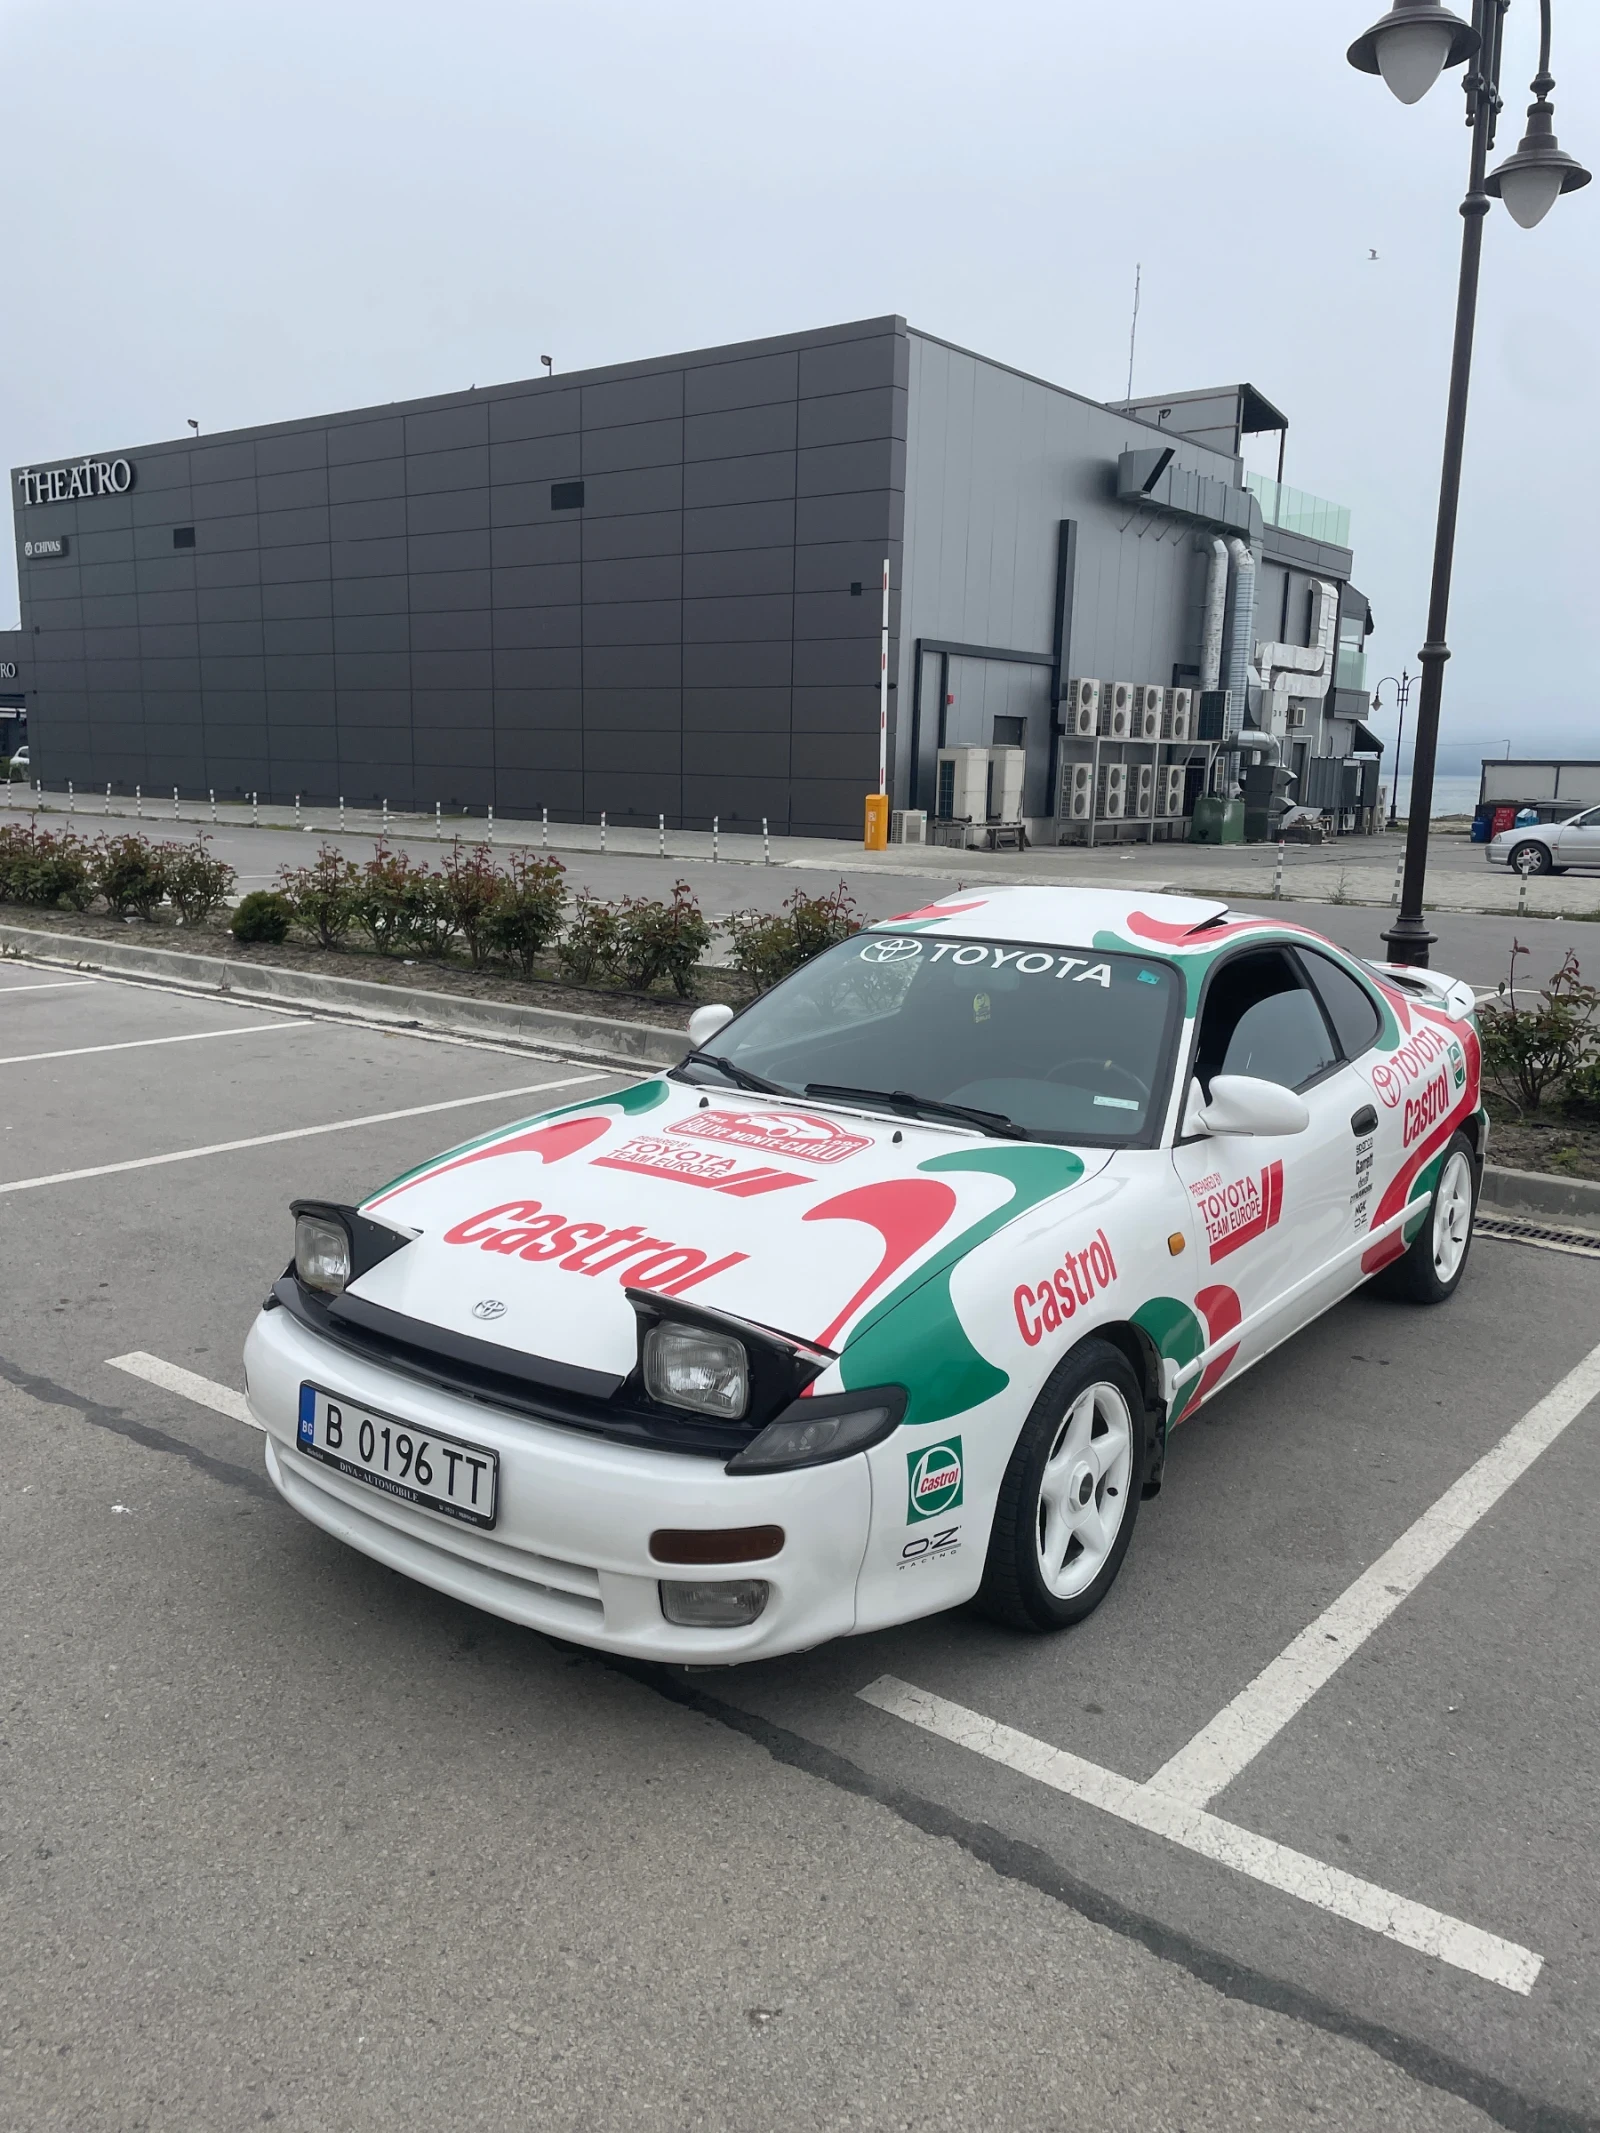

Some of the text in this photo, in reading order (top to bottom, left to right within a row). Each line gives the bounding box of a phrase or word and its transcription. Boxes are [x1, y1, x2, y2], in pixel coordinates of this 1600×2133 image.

[19, 458, 131, 505] THEATRO
[34, 540, 61, 554] CHIVAS
[930, 943, 1112, 988] TOYOTA
[1389, 1026, 1449, 1085] TOYOTA
[1403, 1063, 1449, 1149] Castrol
[620, 1140, 737, 1171] TOYOTA
[635, 1135, 679, 1147] PREPARED
[676, 1117, 853, 1160] RALLYE MONTE-CARLO
[607, 1149, 728, 1178] TEAM EUROPE
[1188, 1172, 1223, 1198] PREPARED BY
[1197, 1176, 1258, 1223] TOYOTA
[1205, 1197, 1262, 1243] TEAM EUROPE
[443, 1200, 751, 1297] Castrol
[1013, 1228, 1118, 1347] Castrol
[302, 1420, 313, 1436] BG
[326, 1403, 488, 1505] B 0196 TT
[340, 1461, 358, 1478] DIVA
[362, 1473, 419, 1502] AUTOMOBILE
[920, 1467, 959, 1493] Castrol
[898, 1549, 957, 1571] RACING
